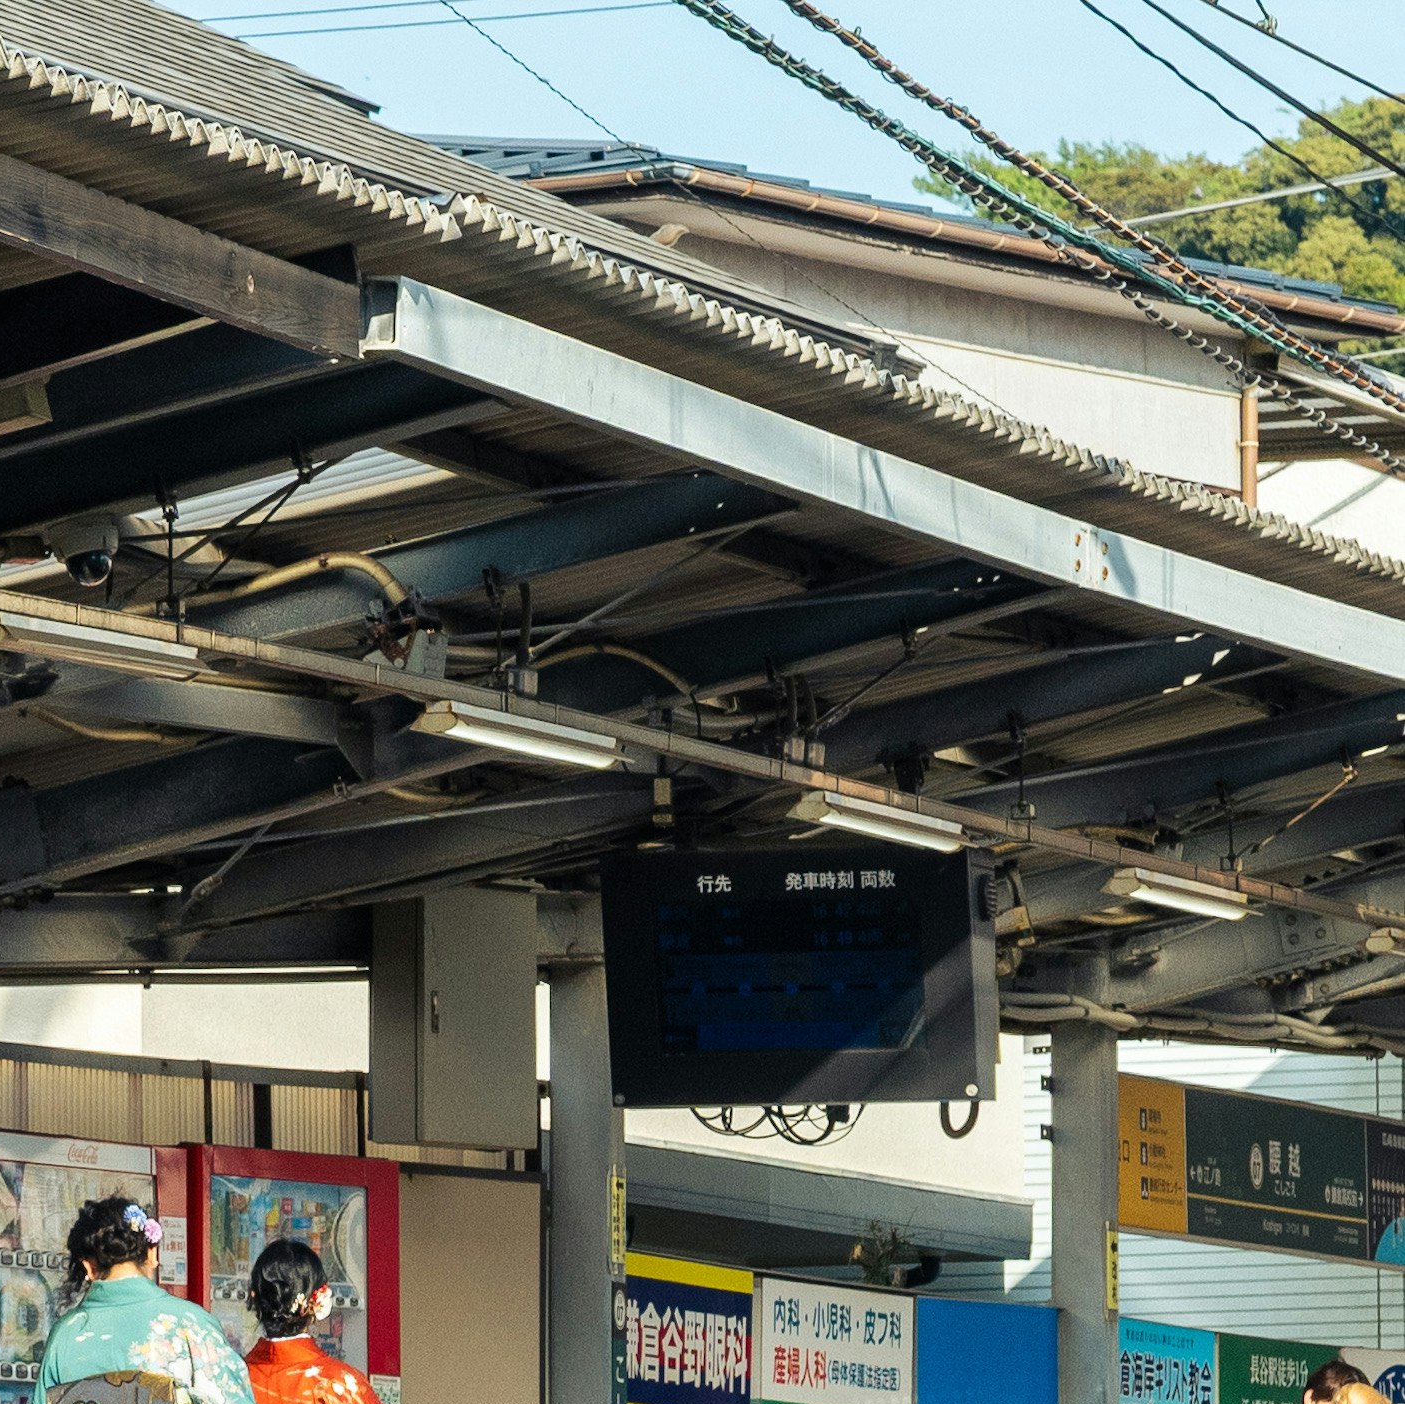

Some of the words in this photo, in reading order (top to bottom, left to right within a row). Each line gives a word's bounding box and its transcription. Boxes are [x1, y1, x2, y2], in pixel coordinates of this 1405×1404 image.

[696, 875, 732, 894] 行先
[785, 870, 855, 891] 発車時刻
[860, 869, 897, 889] 両数
[1268, 1140, 1301, 1178] 腰越
[773, 1296, 902, 1349] 内科・小児科・皮フ科
[773, 1345, 827, 1389] 産婦人科
[1249, 1354, 1309, 1388] 長谷駅徒歩1分
